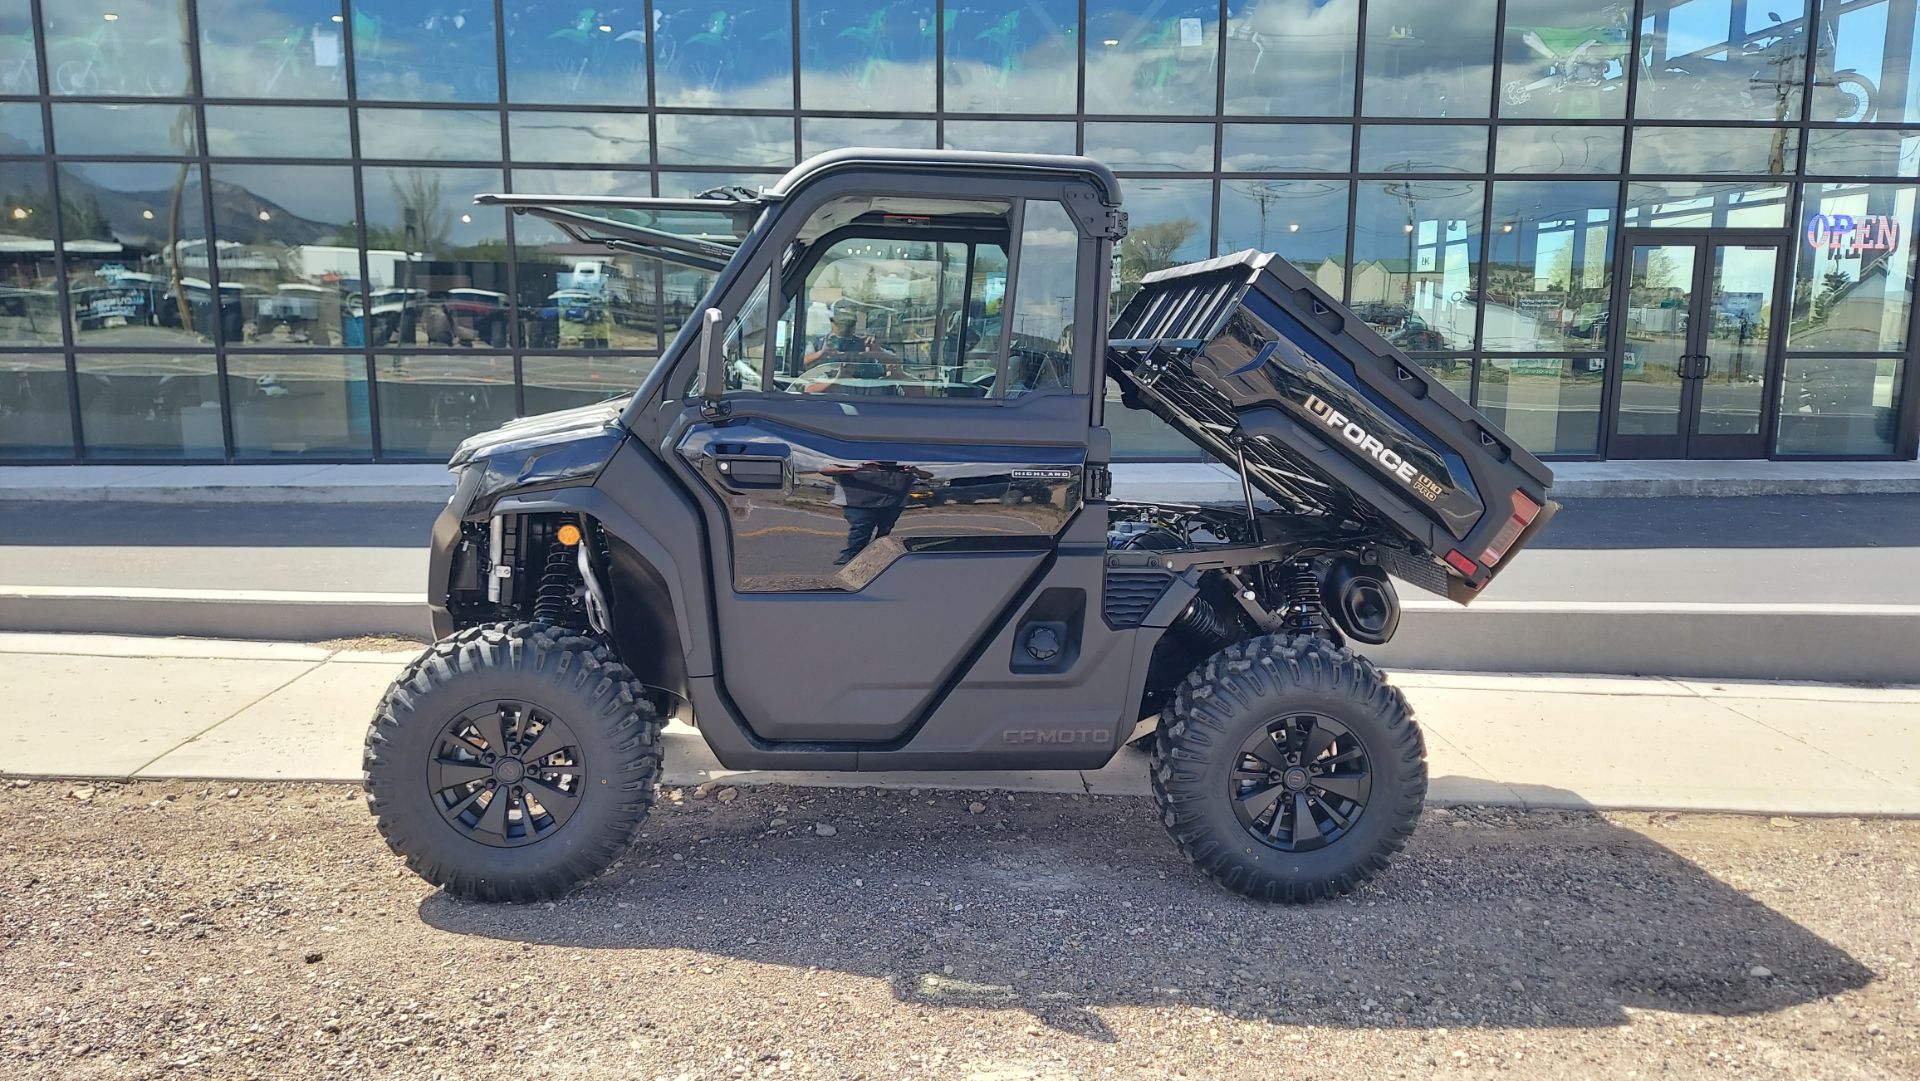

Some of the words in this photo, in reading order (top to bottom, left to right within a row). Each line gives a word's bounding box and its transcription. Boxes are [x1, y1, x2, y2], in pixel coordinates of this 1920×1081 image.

[1807, 214, 1898, 251] OPEN
[1304, 394, 1418, 485] UFORCE
[1413, 482, 1437, 501] PRO
[1418, 474, 1443, 495] U10
[1003, 729, 1109, 743] CFMOTO
